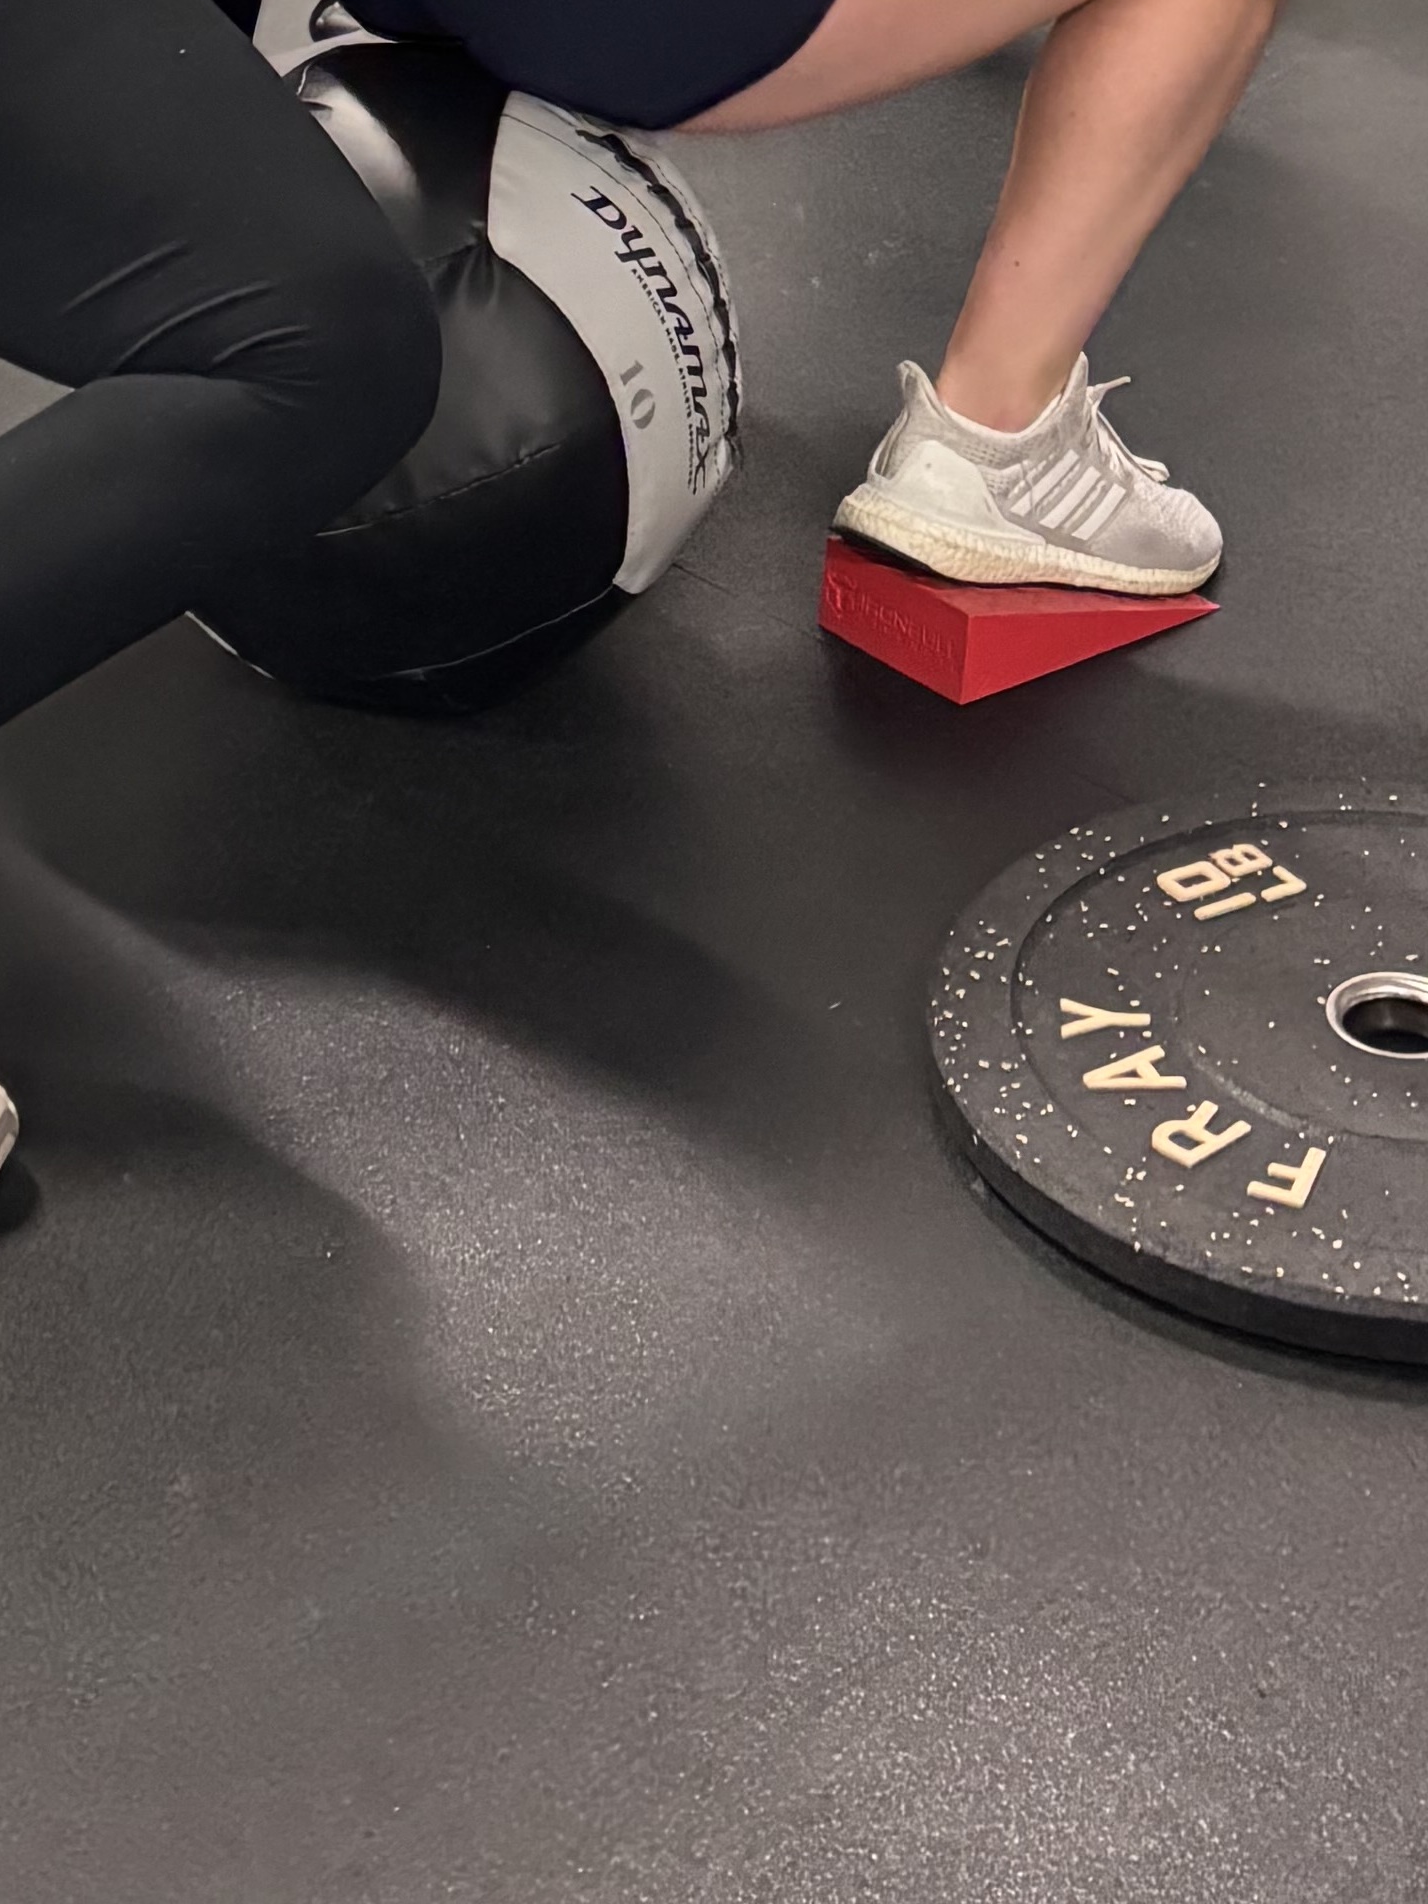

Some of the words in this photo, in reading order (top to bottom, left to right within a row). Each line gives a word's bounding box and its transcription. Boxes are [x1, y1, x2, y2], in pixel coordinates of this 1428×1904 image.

[620, 360, 656, 430] 10
[1156, 859, 1256, 921] 10
[1209, 843, 1308, 904] LB
[1059, 997, 1327, 1209] FRAY
